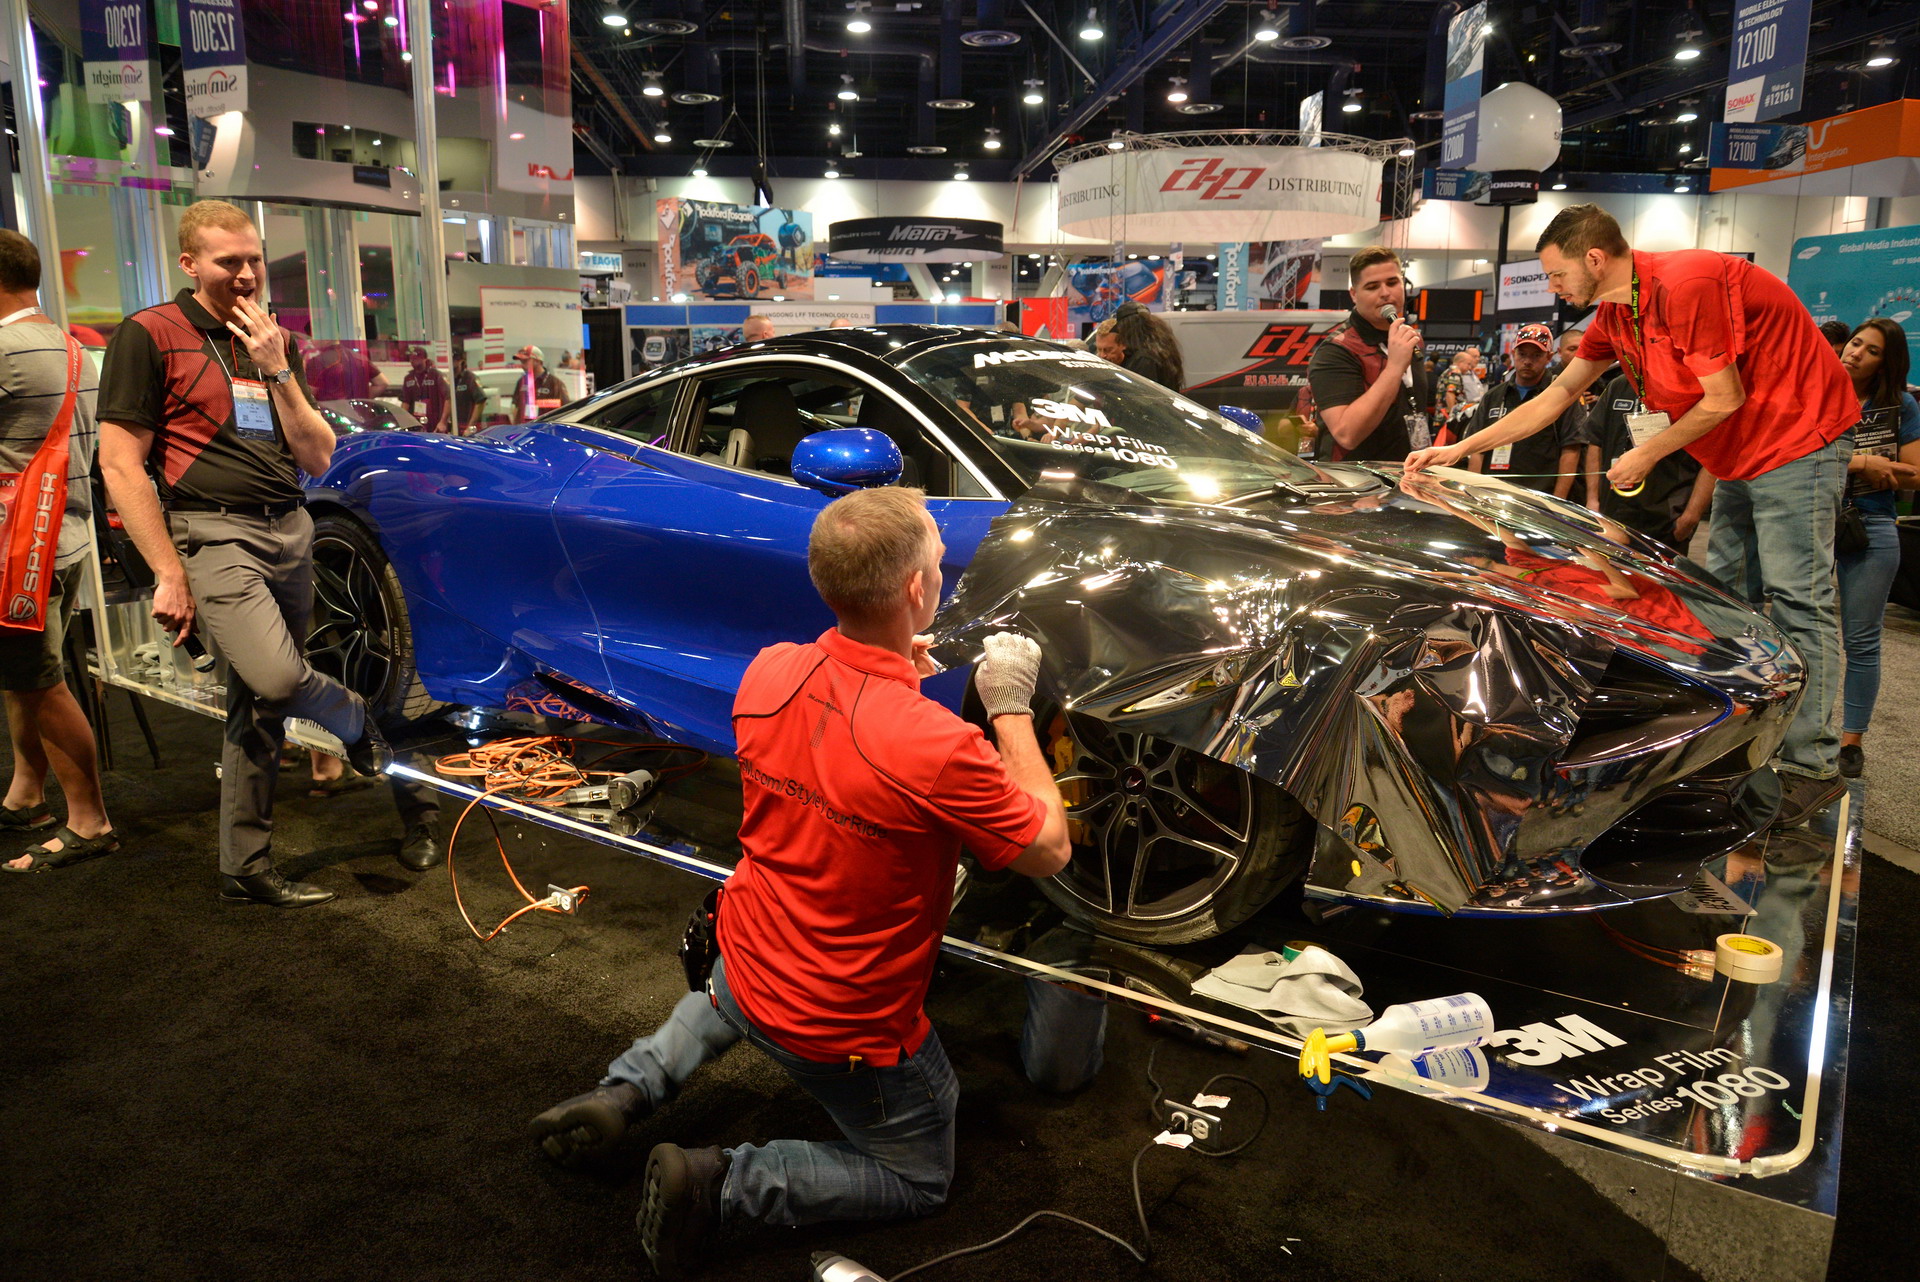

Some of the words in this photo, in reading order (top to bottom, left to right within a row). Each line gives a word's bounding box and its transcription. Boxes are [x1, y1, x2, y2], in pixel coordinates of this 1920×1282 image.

[1739, 1, 1762, 19] MOBILE
[1744, 6, 1784, 28] TECHNOLOGY
[1737, 23, 1777, 70] 12100
[1727, 93, 1755, 109] SONAX
[1764, 87, 1794, 107] #12161
[1444, 134, 1465, 163] 12000
[1729, 142, 1756, 162] 12100
[1268, 177, 1362, 198] DISTRIBUTING
[1436, 182, 1456, 197] 12000
[1839, 242, 1864, 253] Global
[1865, 240, 1890, 251] Media
[1031, 398, 1112, 428] 3M
[1042, 423, 1111, 446] Wrap
[1117, 435, 1168, 455] Film
[1051, 440, 1102, 454] Series
[1103, 446, 1178, 469] 1080
[23, 472, 58, 593] SPYDER
[1491, 1014, 1628, 1066] 3M
[1553, 1065, 1665, 1101] Wrap
[1654, 1046, 1742, 1076] Film
[1600, 1094, 1683, 1125] Series
[1676, 1066, 1790, 1110] 1080
